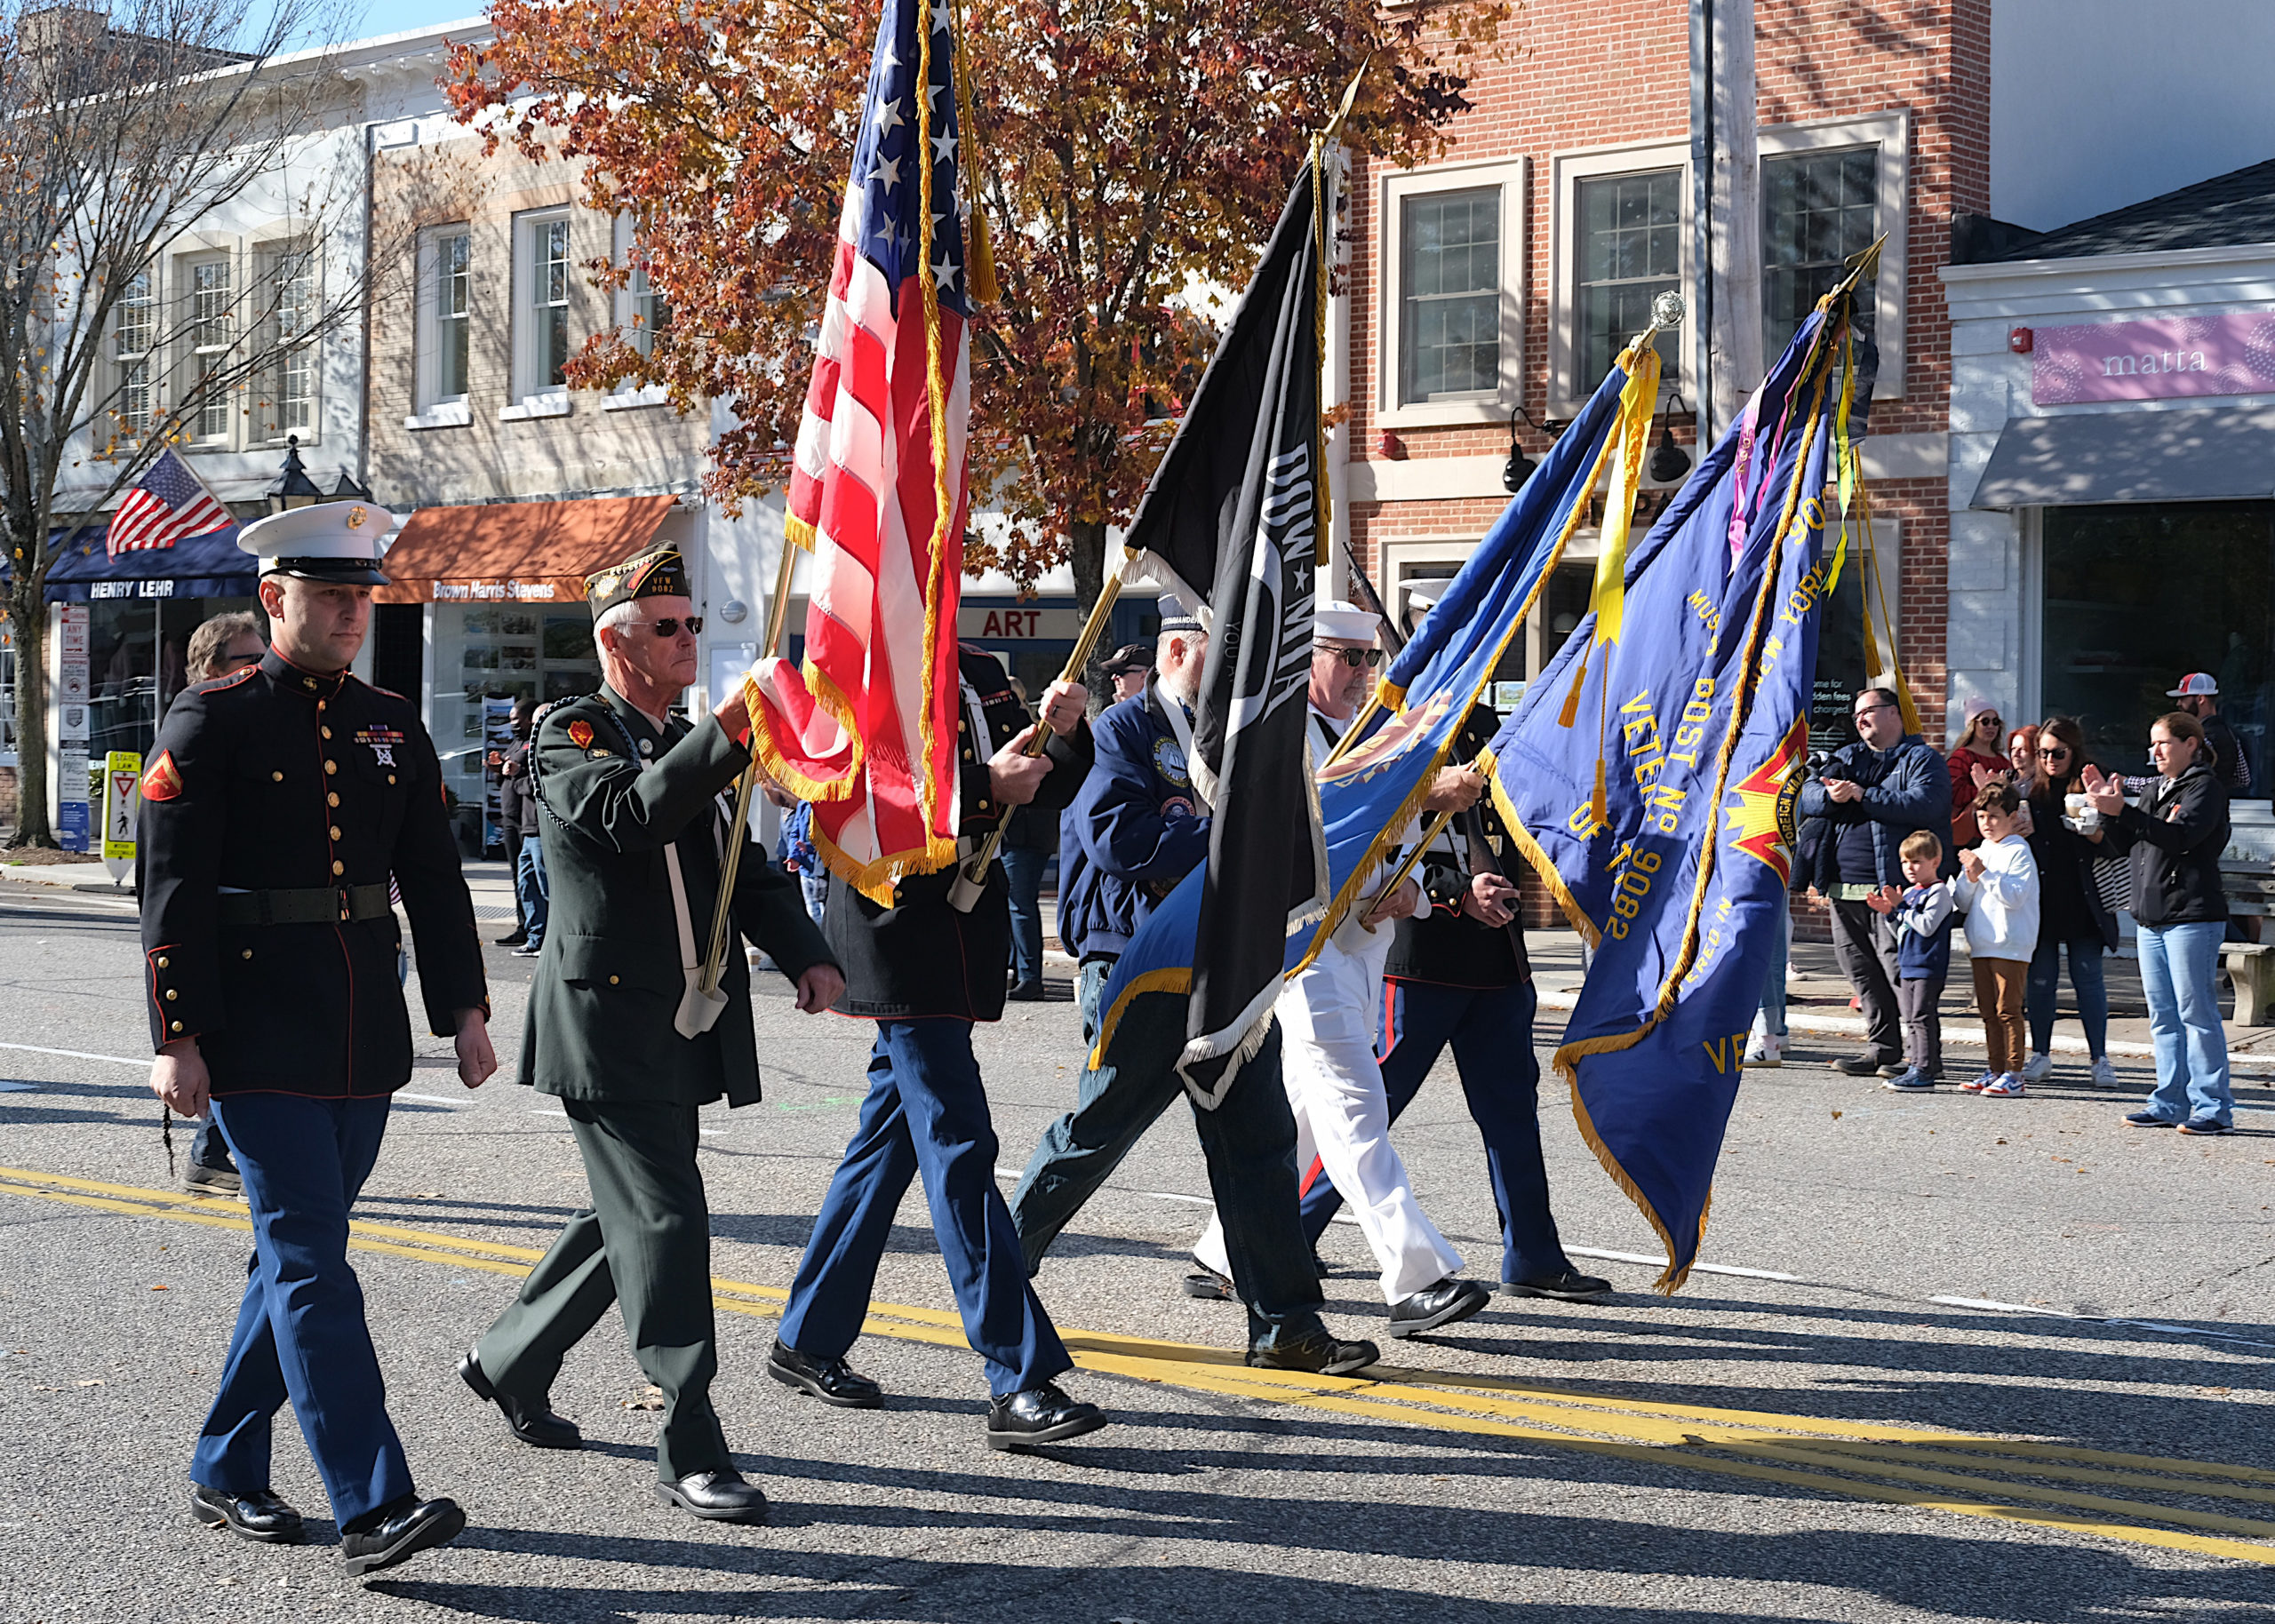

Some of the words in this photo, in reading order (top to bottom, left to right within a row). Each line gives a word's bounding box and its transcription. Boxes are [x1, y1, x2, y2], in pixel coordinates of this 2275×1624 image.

[2102, 349, 2208, 377] matta
[1260, 439, 1315, 563] POW
[1789, 487, 1826, 545] 90
[91, 581, 134, 599] HENRY
[139, 579, 174, 598] LEHR
[433, 580, 468, 599] Brown
[469, 579, 506, 599] Harris
[507, 578, 555, 599] Stevens
[1778, 559, 1824, 625] YORK
[982, 610, 1041, 637] ART
[1224, 620, 1242, 659] YOU
[1261, 593, 1315, 725] MIA
[1831, 678, 1843, 688] for
[1833, 691, 1852, 701] fees
[1669, 678, 1716, 768] POST
[1779, 797, 1796, 848] FOREIGN
[1603, 848, 1663, 941] 9082
[1714, 896, 1734, 923] IN
